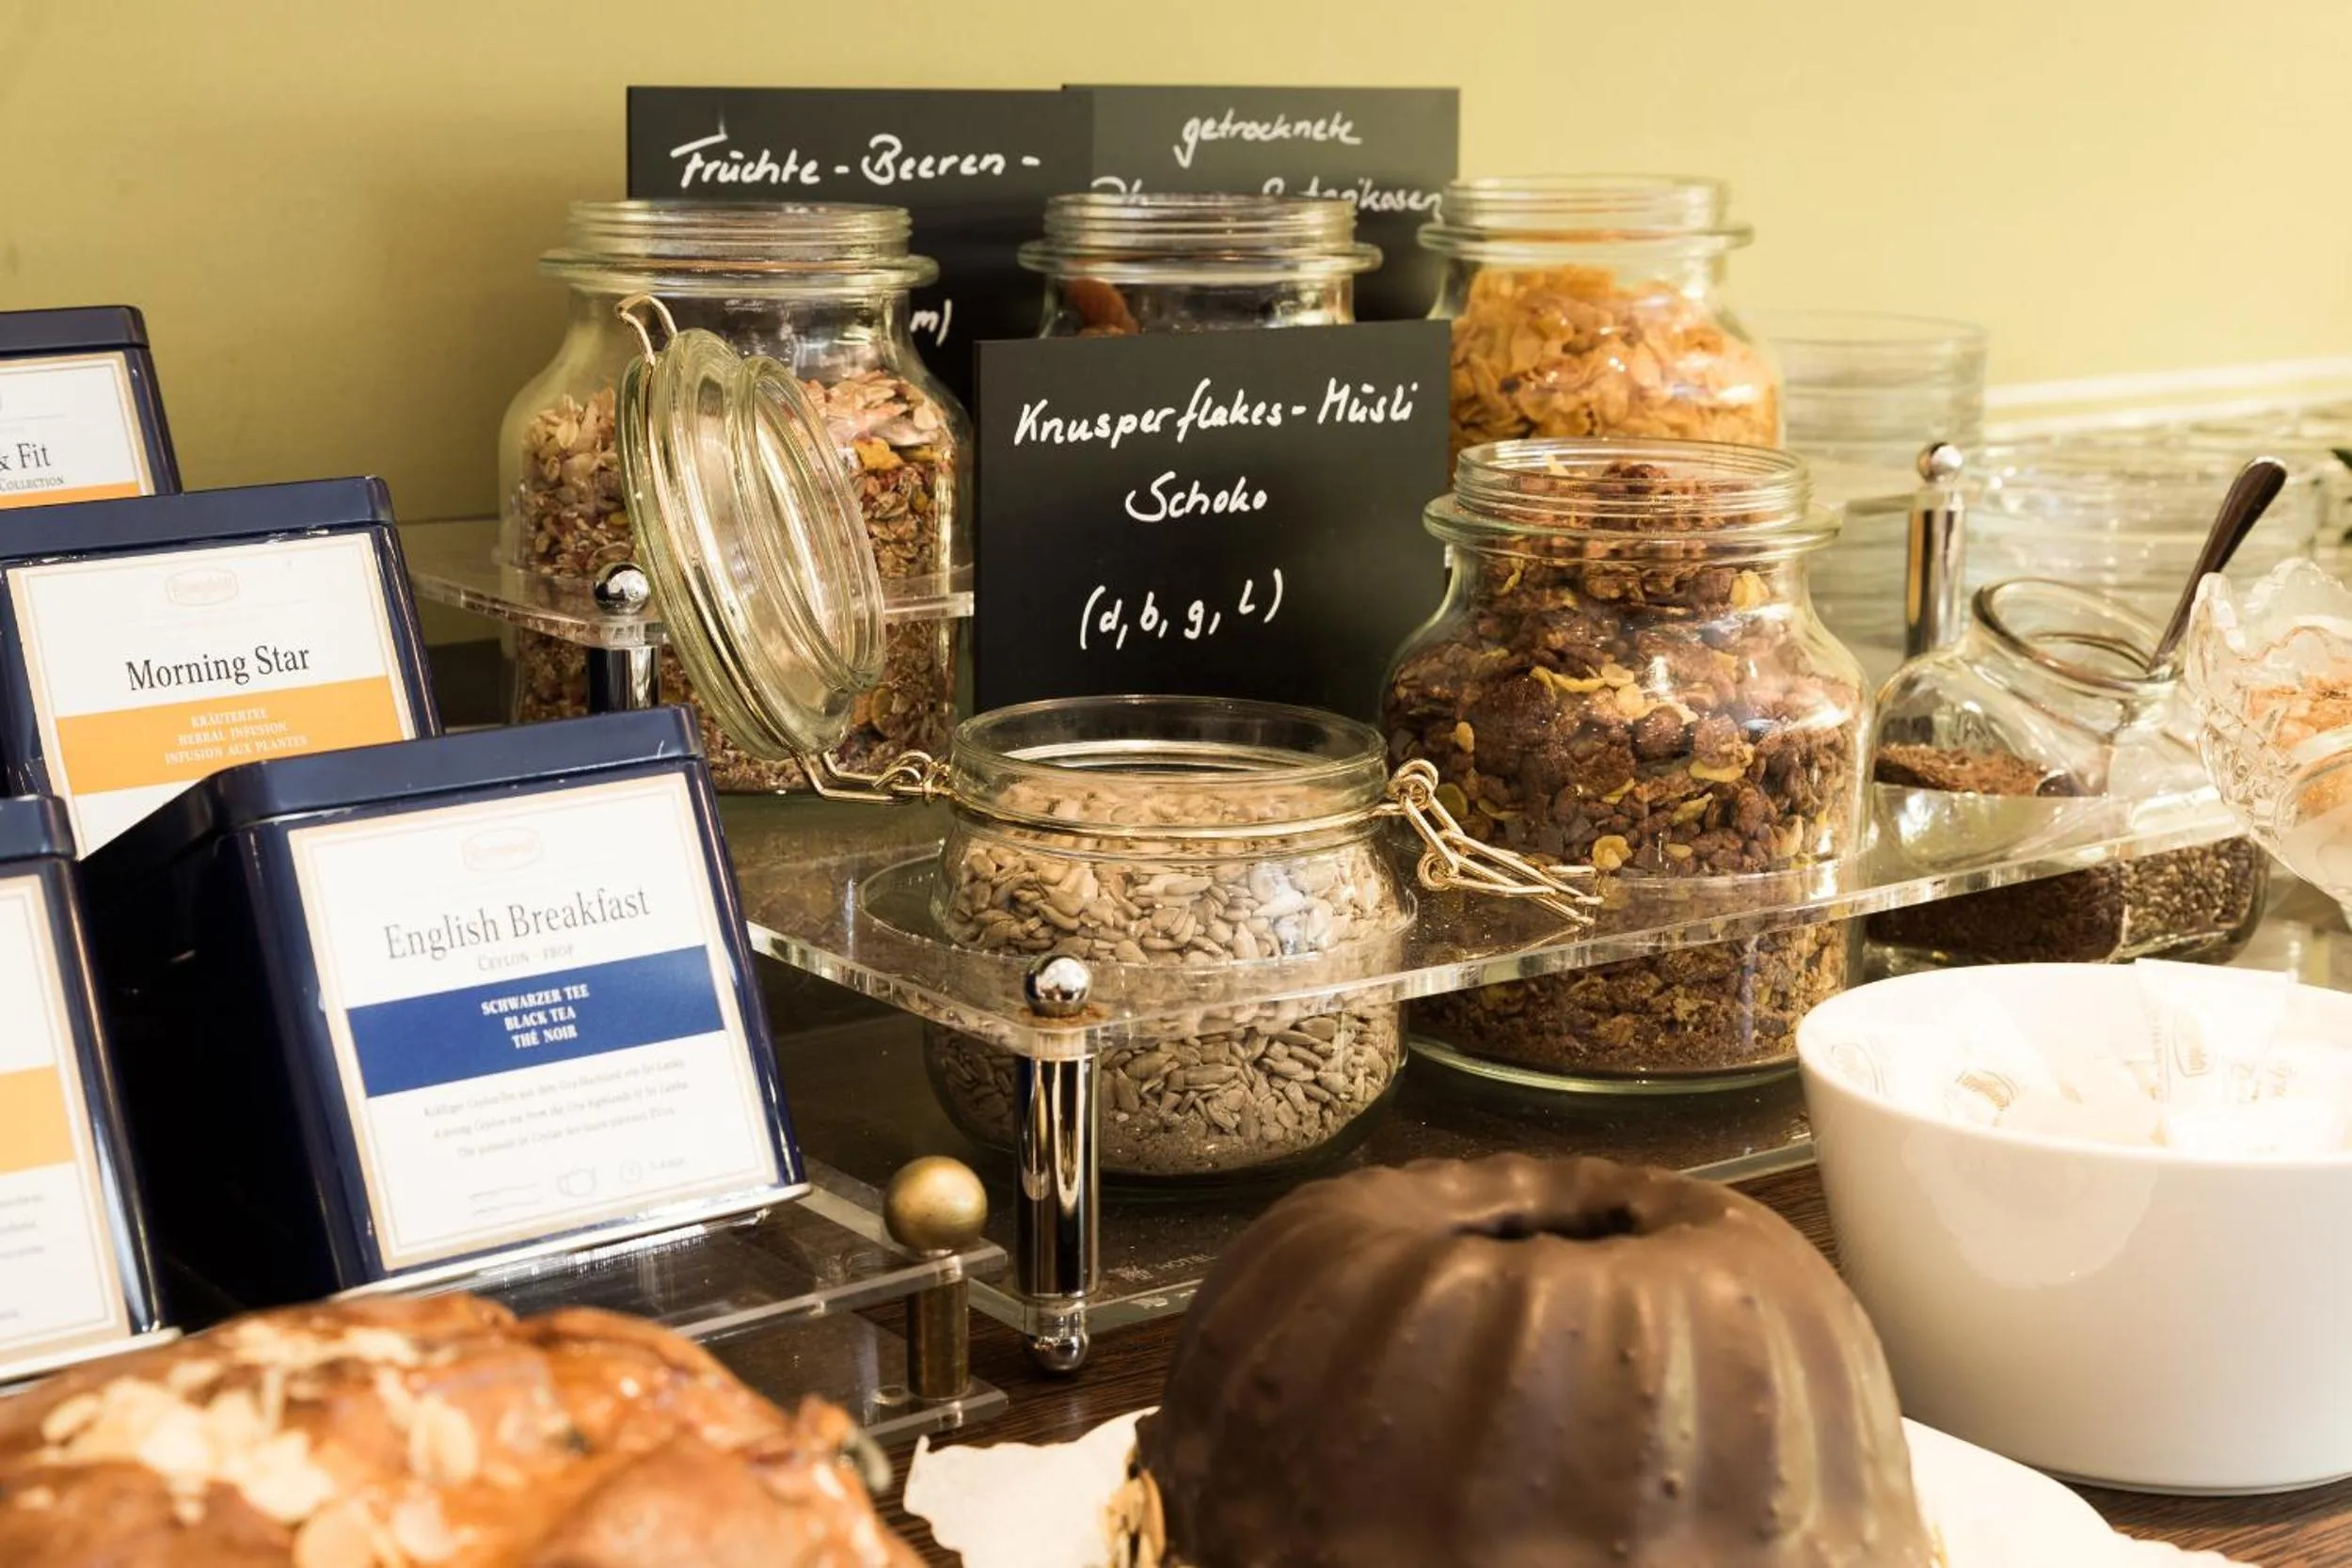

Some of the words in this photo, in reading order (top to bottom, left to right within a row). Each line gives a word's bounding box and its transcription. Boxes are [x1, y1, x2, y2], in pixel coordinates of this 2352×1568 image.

[17, 443, 52, 469] Fit
[1124, 470, 1268, 524] Schoko
[125, 654, 249, 692] Morning
[256, 645, 311, 676] Star
[177, 729, 227, 746] HERBAL
[230, 720, 288, 740] INFUSION
[164, 747, 224, 766] INFUSION
[226, 742, 253, 757] AUX
[254, 734, 309, 752] PLANTES
[382, 906, 502, 965] English
[507, 885, 652, 942] Breakfast
[481, 987, 563, 1017] SCHWARZER
[564, 983, 591, 1002] TEE
[503, 1011, 548, 1032] BLACK
[549, 1006, 578, 1023] TEA
[512, 1030, 539, 1051] THÉ
[543, 1024, 579, 1046] NOIR
